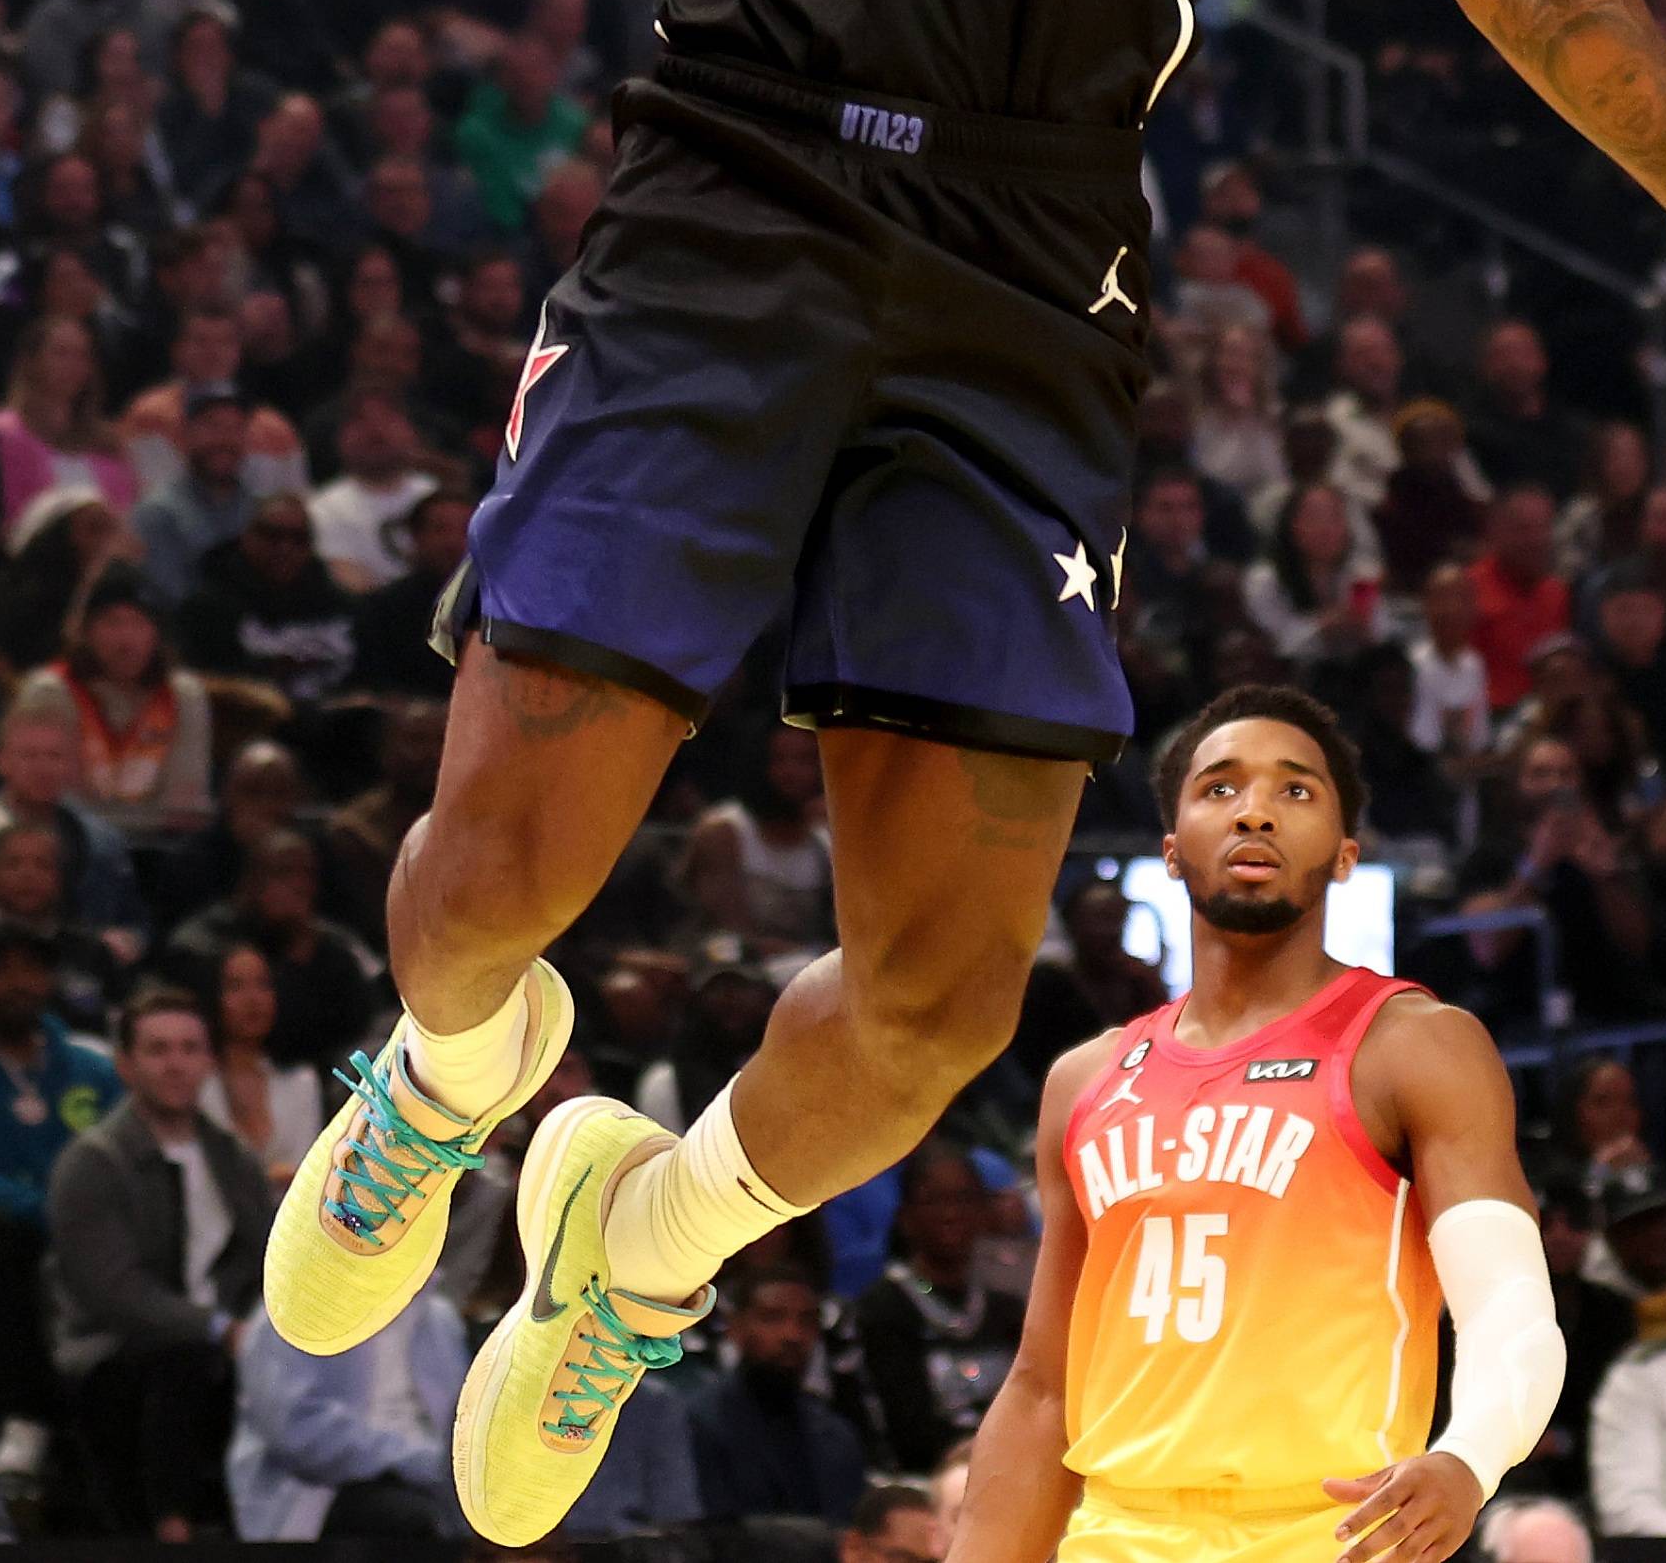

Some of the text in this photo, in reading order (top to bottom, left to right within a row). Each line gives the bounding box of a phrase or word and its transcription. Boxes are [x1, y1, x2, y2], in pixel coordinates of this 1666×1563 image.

[839, 101, 924, 155] UTA23
[1078, 1105, 1315, 1220] ALL-STAR
[1128, 1213, 1229, 1345] 45
